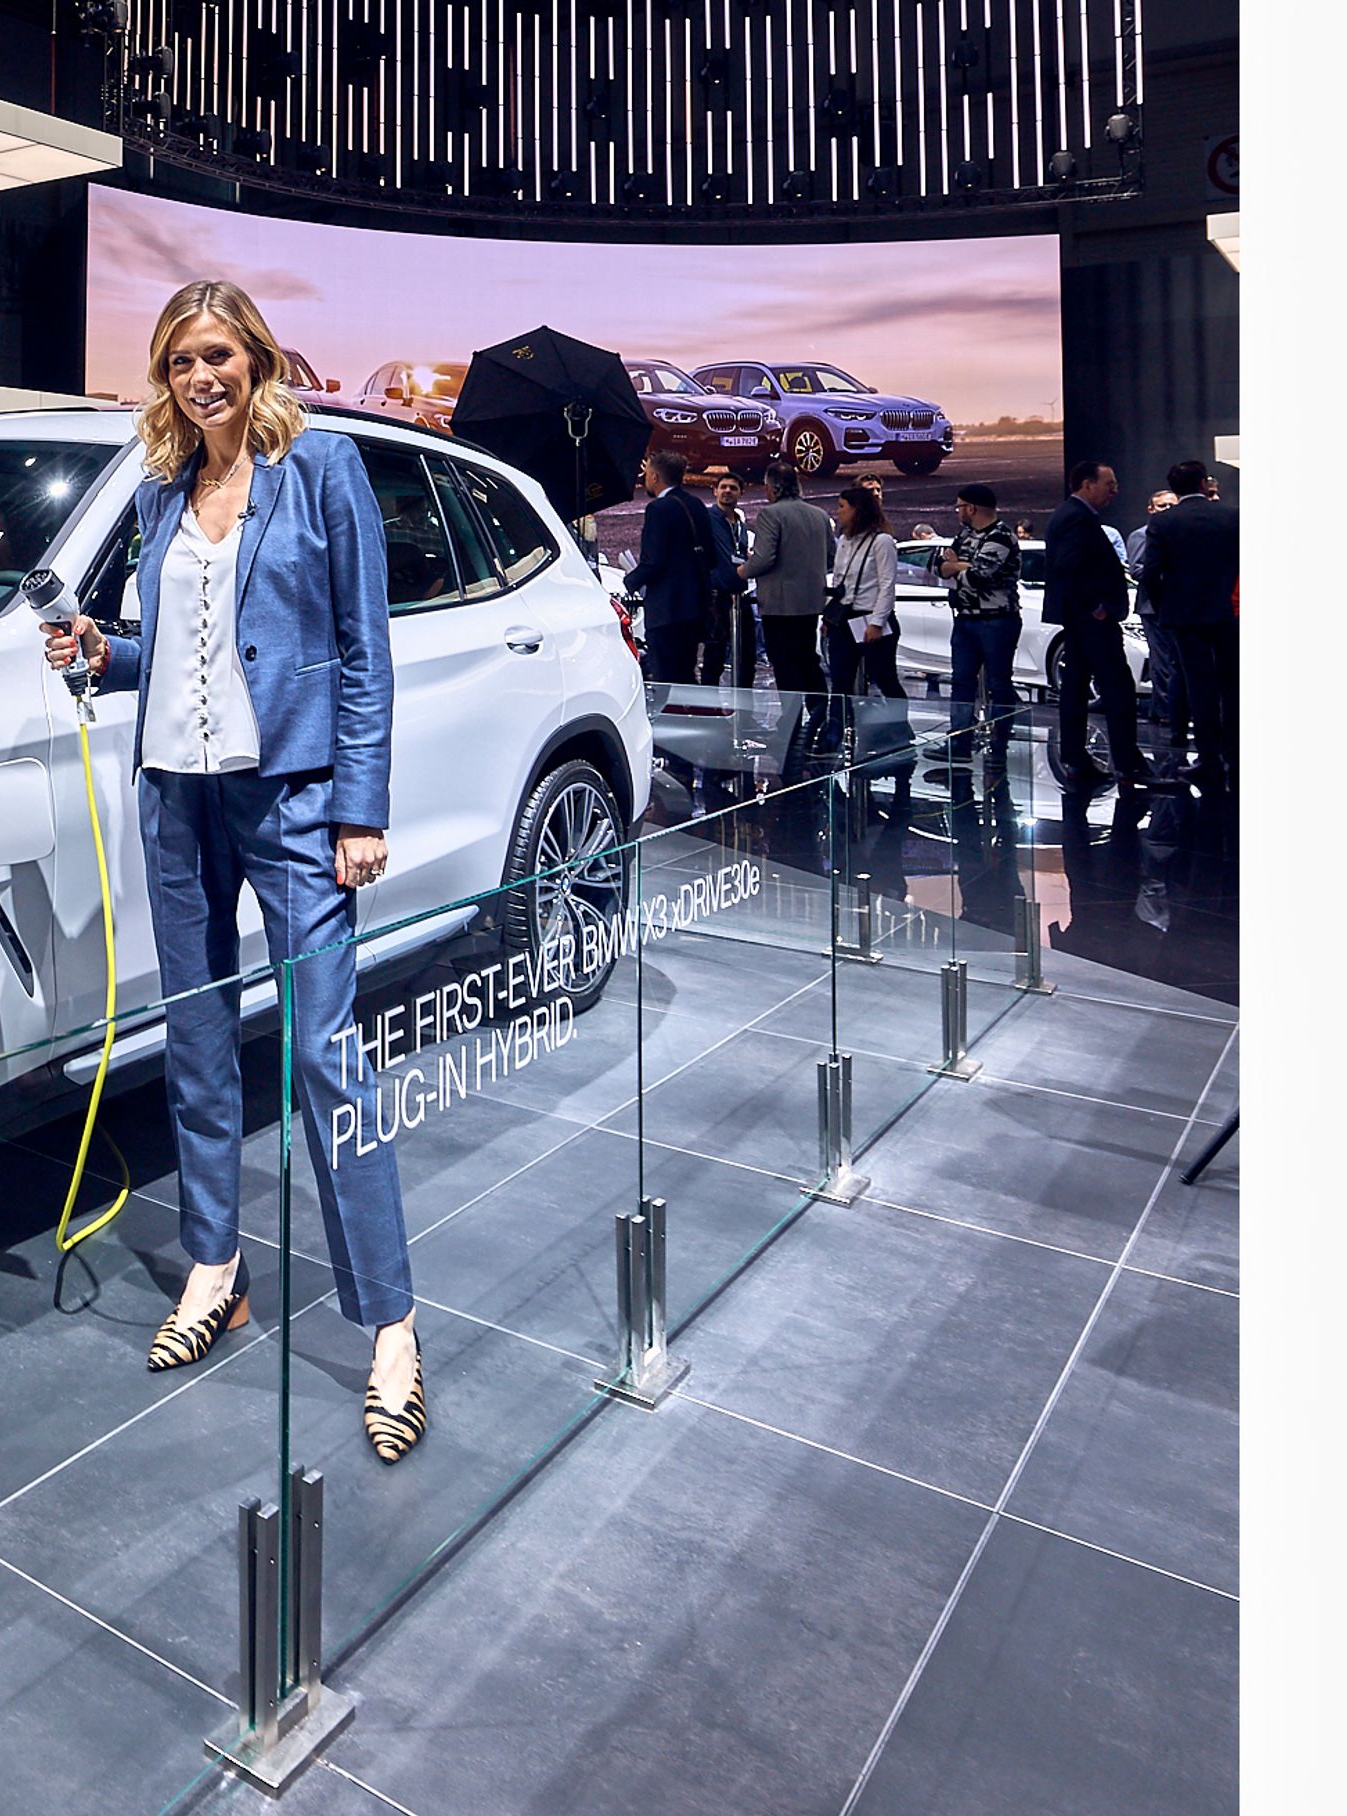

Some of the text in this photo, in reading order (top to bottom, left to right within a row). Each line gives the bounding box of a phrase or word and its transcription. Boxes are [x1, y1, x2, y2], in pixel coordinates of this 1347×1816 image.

[331, 860, 761, 1089] THE FIRST-EVER BMW X3 xDRIVE30e
[331, 996, 578, 1170] PLUG-IN HYBRID.
